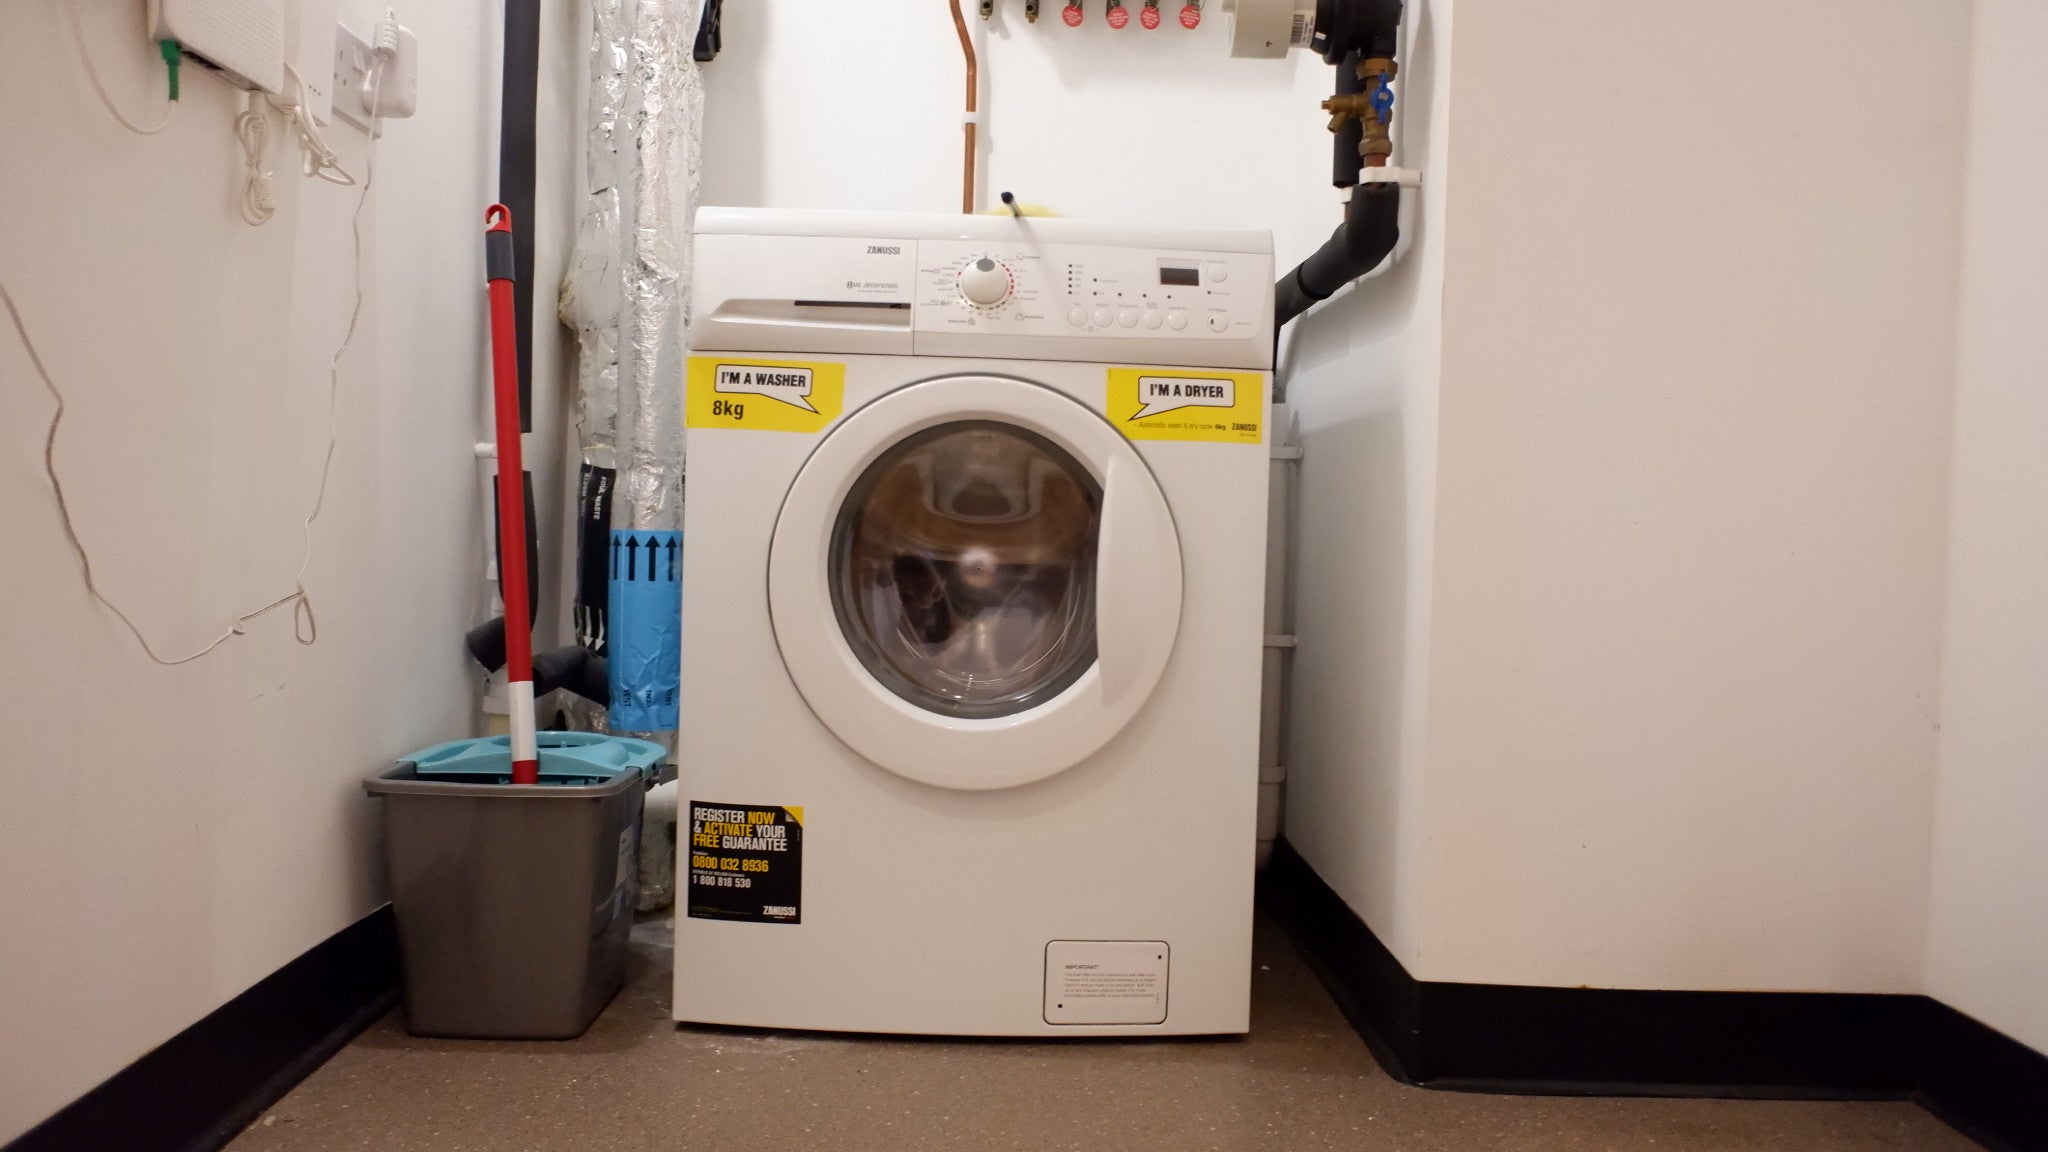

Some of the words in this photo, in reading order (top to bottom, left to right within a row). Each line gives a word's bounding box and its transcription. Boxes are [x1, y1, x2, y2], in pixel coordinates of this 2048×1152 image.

[866, 246, 901, 255] ZANUSSI
[721, 371, 741, 385] I'M
[743, 373, 751, 385] A
[756, 373, 806, 388] WASHER
[1150, 384, 1170, 396] I'M
[1173, 385, 1182, 397] A
[1185, 385, 1224, 398] DRYER
[712, 400, 744, 420] 8kg
[1188, 423, 1198, 431] dry
[1231, 423, 1258, 431] ZANUSSI
[593, 495, 603, 521] WASTE
[693, 807, 745, 824] REGISTER
[747, 811, 776, 825] NOW
[693, 820, 702, 834] &
[703, 821, 754, 837] ACTIVATE
[756, 825, 786, 838] YOUR
[693, 833, 720, 848] FREE
[722, 836, 788, 852] GUARANTEE
[693, 855, 718, 869] 0800
[720, 858, 740, 871] 032
[742, 859, 769, 872] 8936
[693, 875, 697, 884] 1
[699, 875, 716, 886] 800
[717, 877, 733, 887] 818
[734, 878, 751, 888] 530
[763, 905, 797, 916] ZANUSSI
